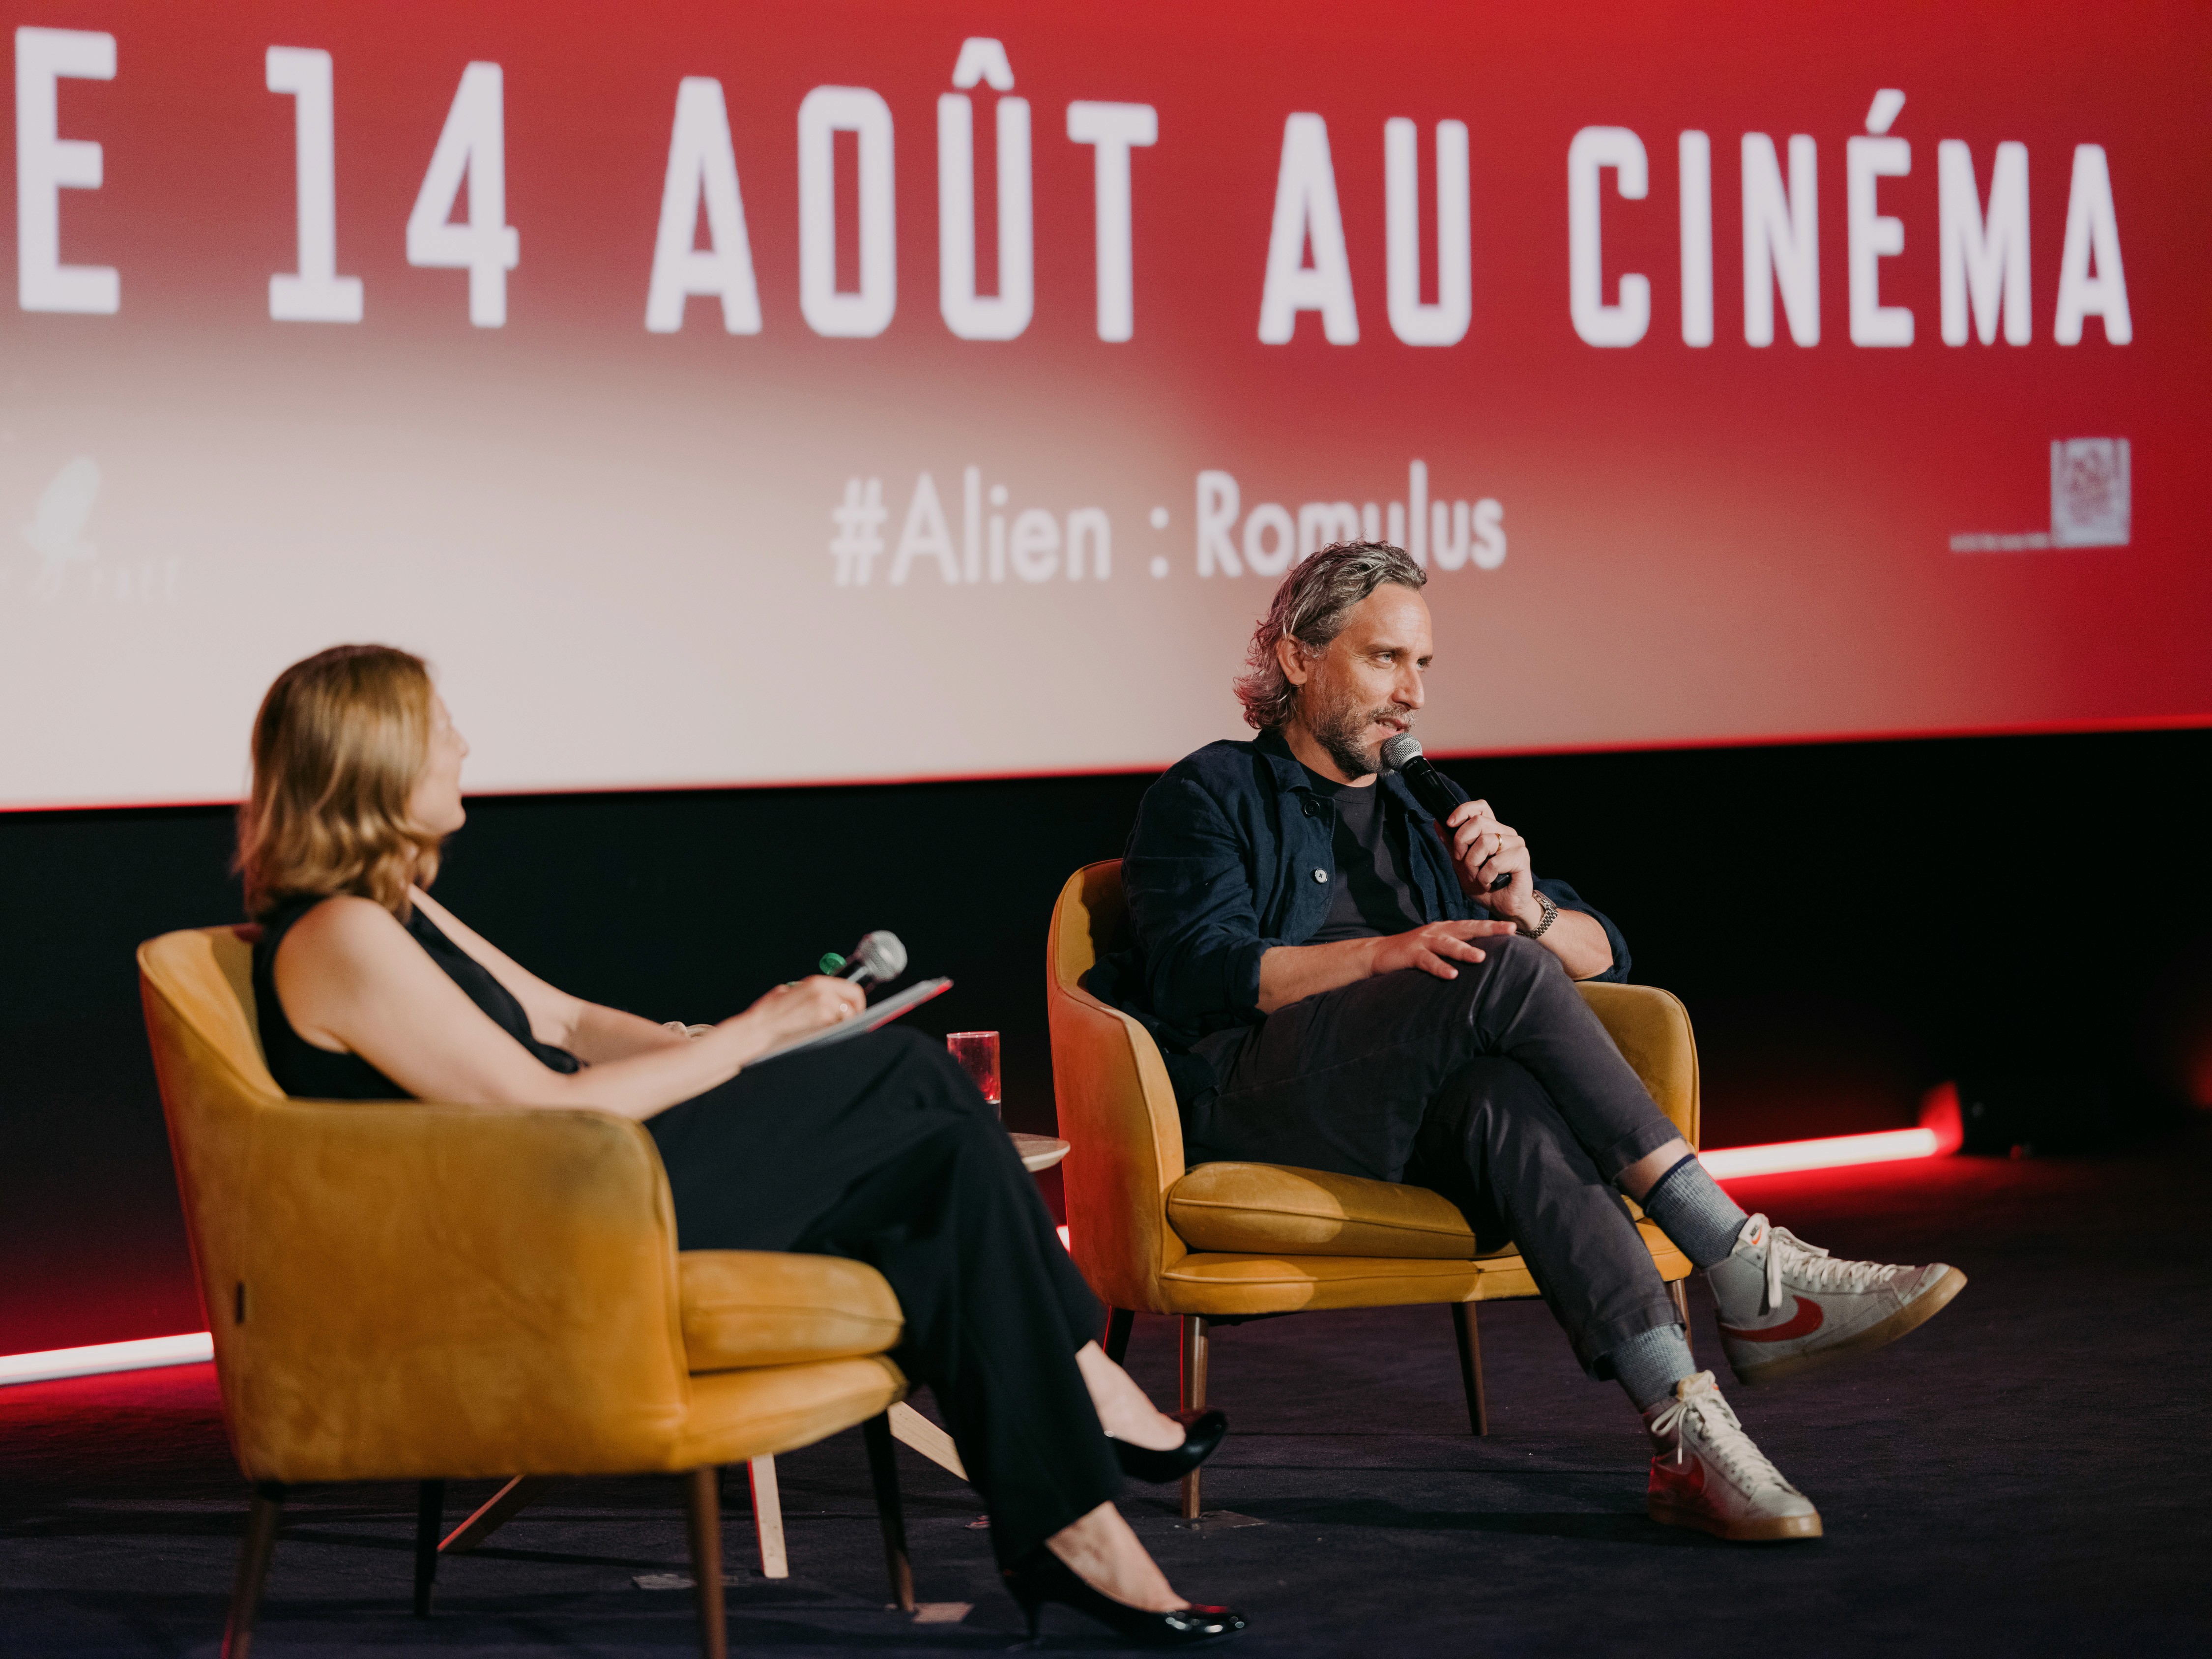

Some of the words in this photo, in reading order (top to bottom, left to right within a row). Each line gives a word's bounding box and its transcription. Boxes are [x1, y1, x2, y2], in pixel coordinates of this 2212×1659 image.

[15, 26, 120, 315] E
[265, 45, 520, 328] 14
[644, 36, 1159, 343] AOÛT
[1258, 112, 1472, 347] AU
[1568, 88, 2133, 349] CINÉMA
[829, 465, 1112, 586] #Alien
